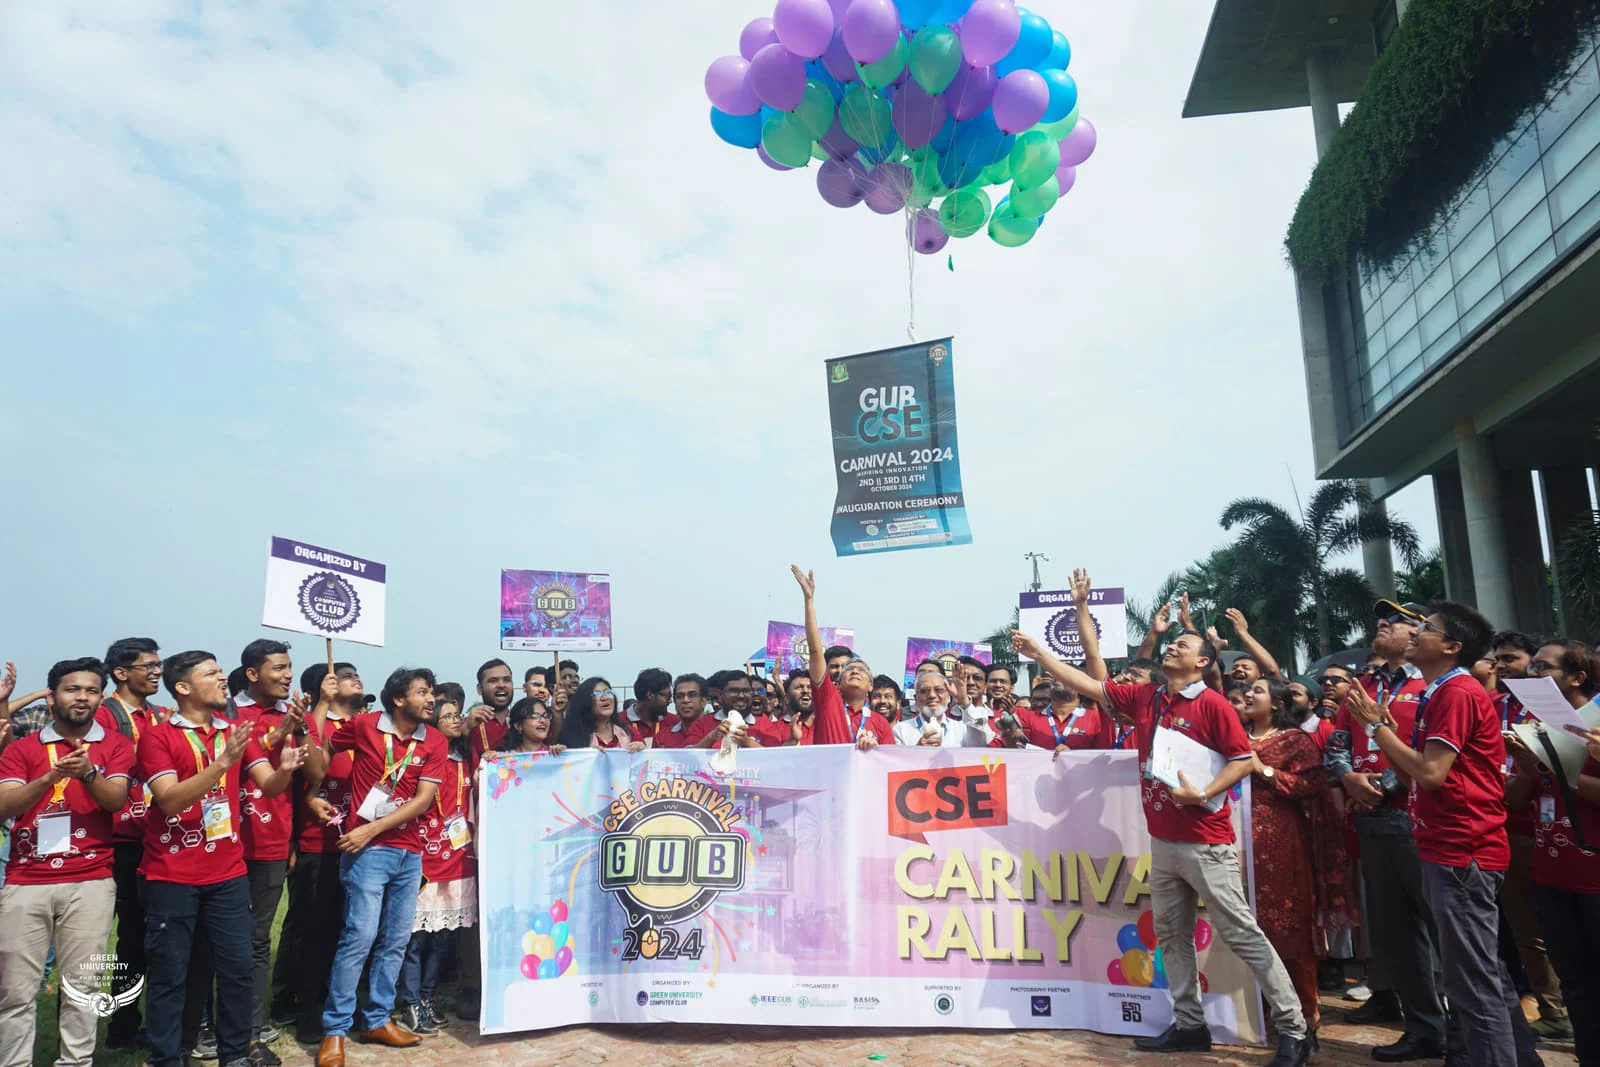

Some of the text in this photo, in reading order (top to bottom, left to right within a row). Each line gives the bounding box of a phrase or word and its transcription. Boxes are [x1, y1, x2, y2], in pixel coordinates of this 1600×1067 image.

[858, 404, 923, 444] CSE
[840, 448, 953, 473] CARNIVAL 2024
[886, 465, 928, 474] INNOVATION
[859, 477, 874, 487] 2ND
[884, 475, 900, 485] 3RD
[909, 473, 925, 484] 4TH
[871, 483, 913, 493] OCTOBER 2024
[836, 496, 958, 514] INAUGURATION CEREMONY
[294, 545, 367, 573] ORGANIZED BY
[314, 596, 346, 608] COMPUTER
[1092, 592, 1105, 600] BY
[315, 603, 345, 616] CLUB
[1060, 635, 1080, 643] CLU
[603, 778, 742, 832] CSE CARNIVAL
[895, 774, 994, 823] CSE
[612, 841, 726, 875] GUB
[894, 846, 1206, 907] CARNIVA
[622, 927, 705, 961] 2024
[896, 904, 1083, 966] RALLY
[649, 991, 703, 999] GREEN UNIVERSITY
[1127, 993, 1152, 1001] PARTNER
